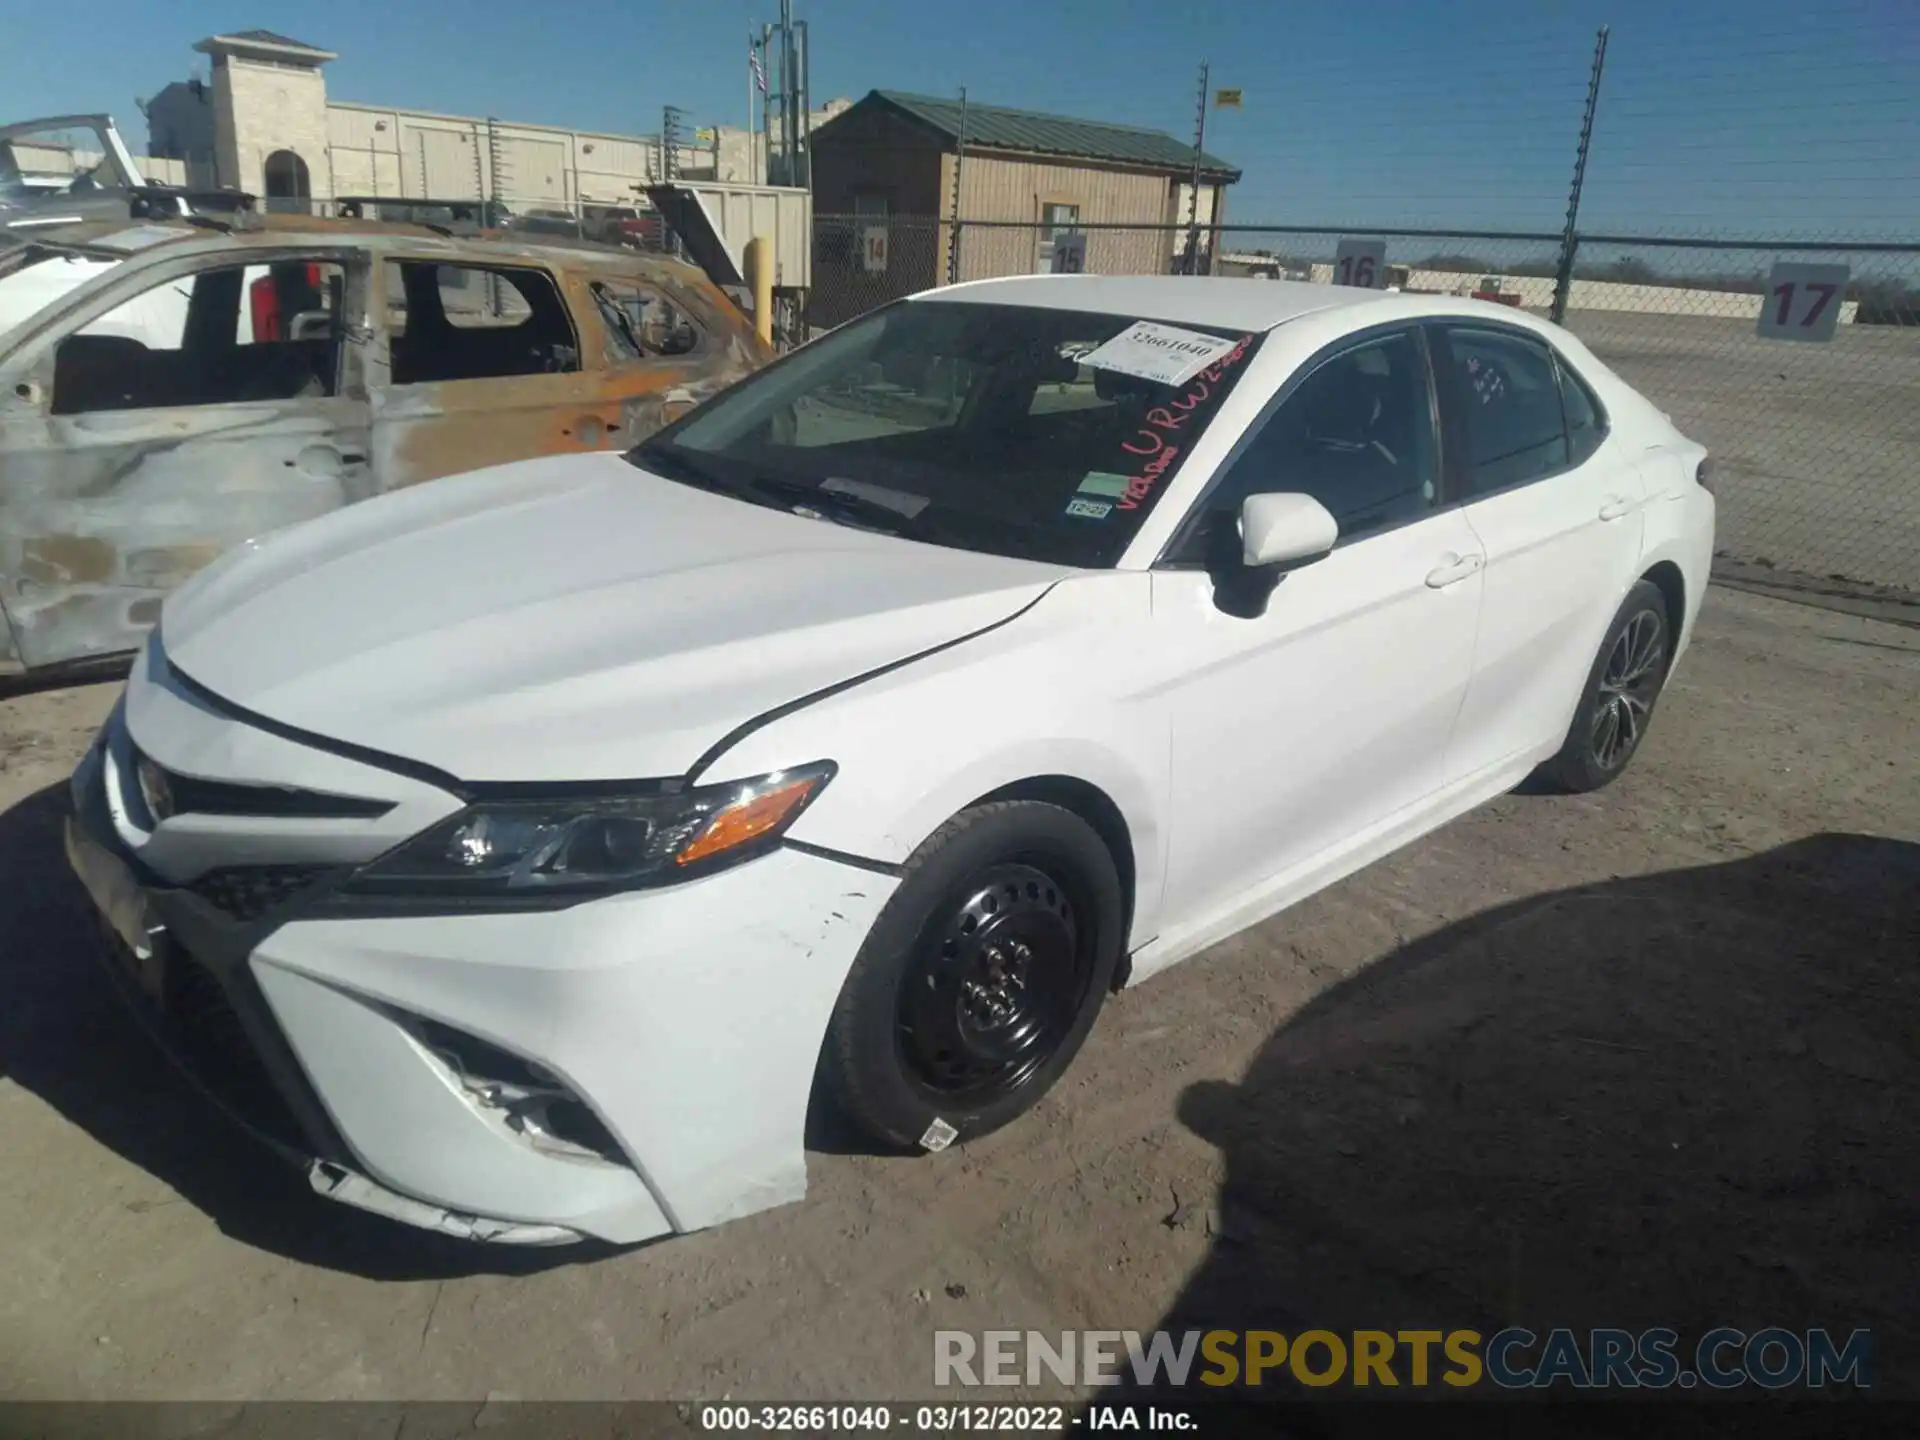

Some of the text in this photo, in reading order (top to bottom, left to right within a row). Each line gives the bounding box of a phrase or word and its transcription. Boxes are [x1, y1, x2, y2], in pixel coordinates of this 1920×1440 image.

[868, 236, 884, 262] 14
[1057, 246, 1080, 274] 15
[1340, 255, 1375, 287] 16
[1774, 282, 1836, 327] 17
